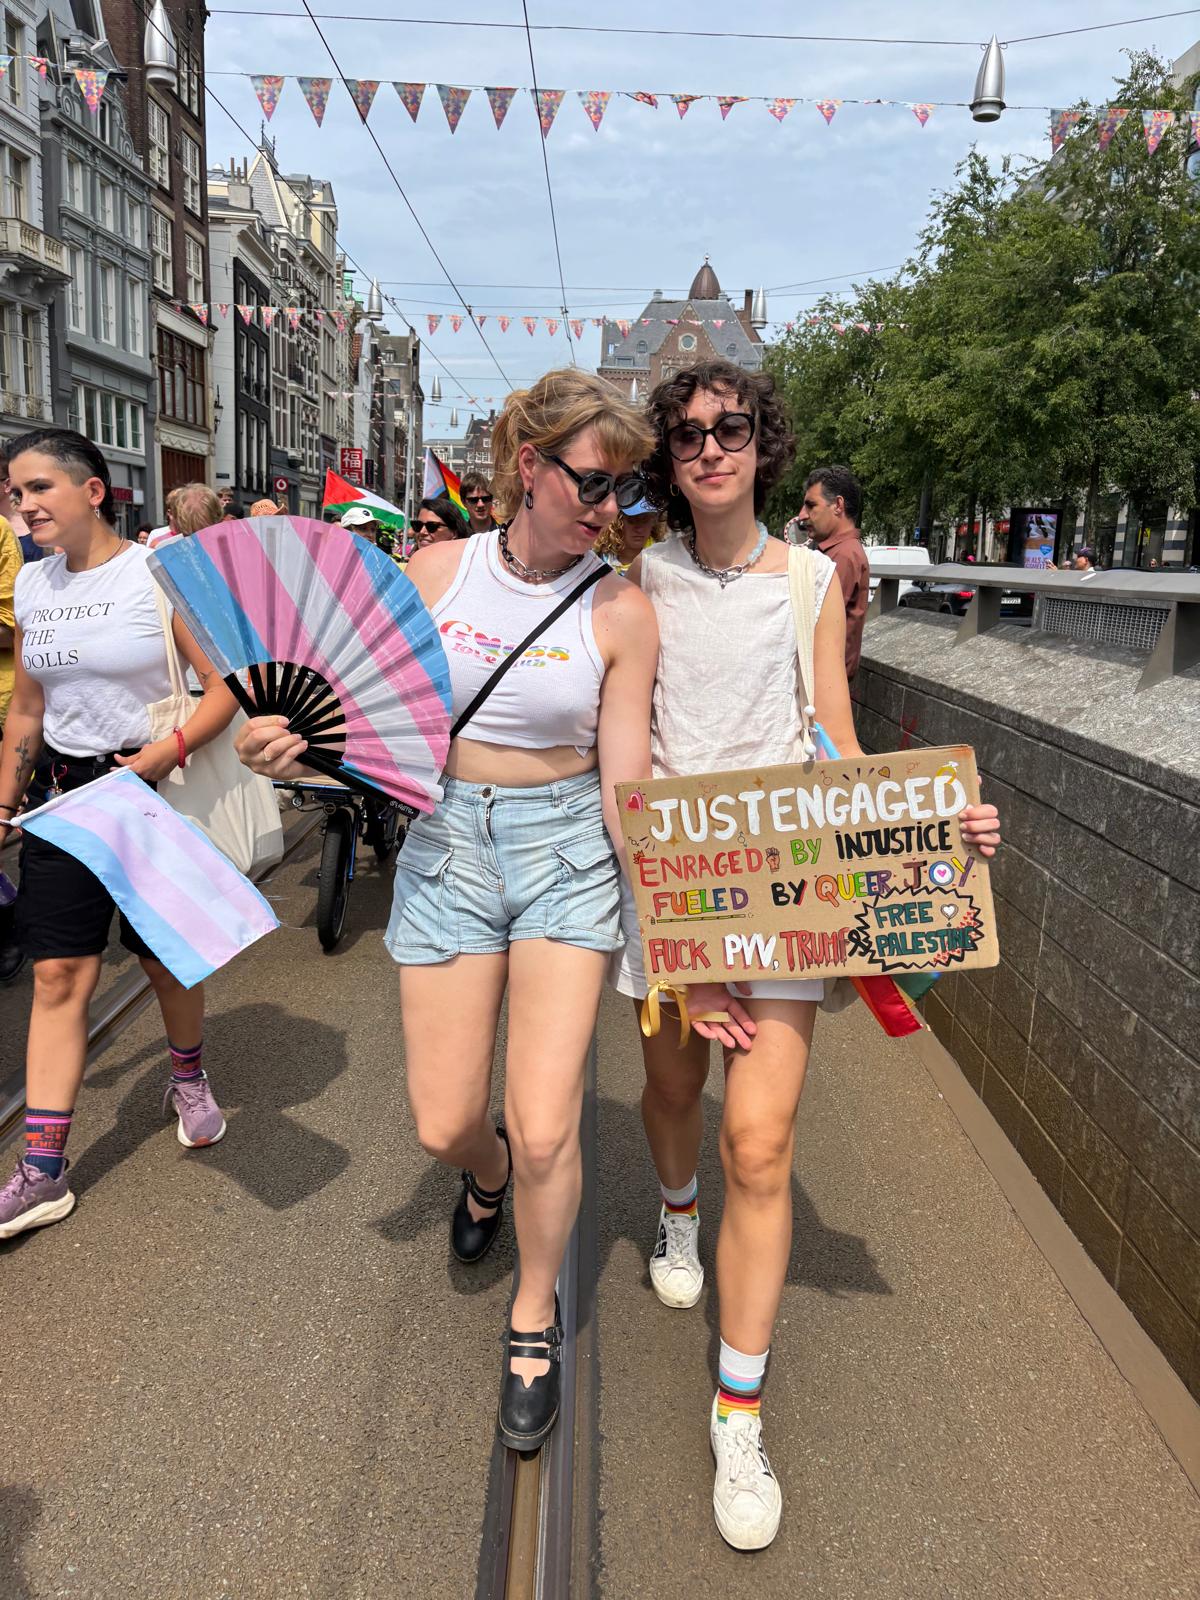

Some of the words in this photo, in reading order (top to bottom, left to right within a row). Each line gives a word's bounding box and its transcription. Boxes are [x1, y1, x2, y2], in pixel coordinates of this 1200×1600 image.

[31, 602, 116, 624] PROTECT
[25, 629, 55, 646] THE
[24, 649, 79, 670] DOLLS
[649, 788, 766, 843] JUST
[769, 774, 968, 833] ENGAGED
[638, 848, 763, 887] ENRAGED
[790, 838, 822, 866] BY
[653, 887, 749, 917] FUELED
[771, 878, 808, 906] BY
[815, 869, 894, 908] QUEER
[902, 856, 976, 889] JOY
[874, 901, 934, 928] FREE
[649, 937, 712, 973] FUCK
[876, 926, 976, 956] PALESTINE
